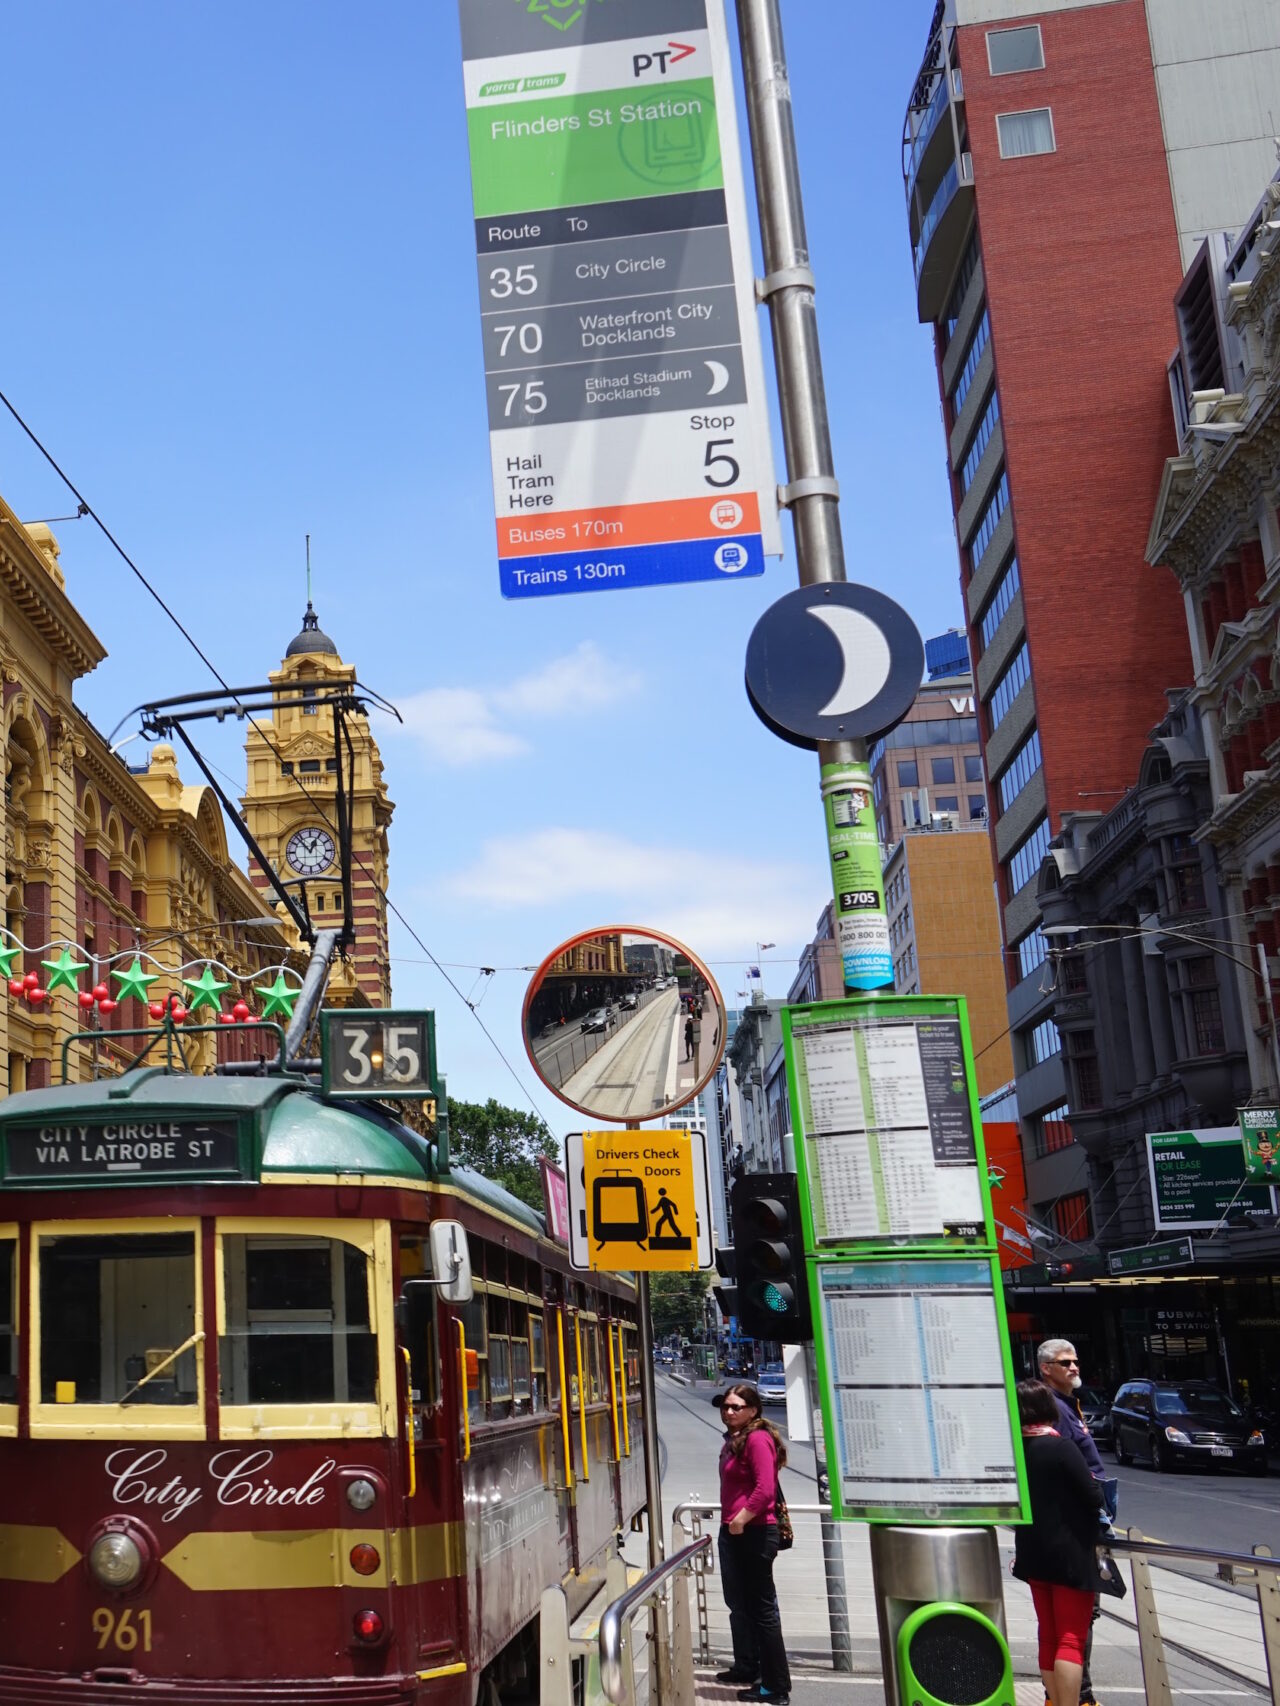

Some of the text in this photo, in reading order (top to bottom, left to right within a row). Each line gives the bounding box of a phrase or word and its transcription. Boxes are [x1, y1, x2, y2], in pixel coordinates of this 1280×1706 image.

[490, 98, 703, 140] Flinders St Station
[487, 217, 588, 243] Route To
[575, 255, 667, 281] City Circle
[488, 264, 539, 299] 35
[578, 302, 714, 332] Waterfront City
[493, 322, 543, 357] 70
[581, 324, 676, 348] Docklands
[584, 367, 693, 391] Etihad Stadium
[498, 380, 548, 417] 75
[585, 383, 661, 404] Docklands
[689, 414, 736, 432] Stop
[506, 454, 543, 472] Hail
[703, 437, 741, 489] 5
[507, 473, 555, 491] Tram
[508, 493, 554, 510] Here
[508, 518, 624, 545] Buses 170m
[512, 561, 627, 587] Trains 130m
[843, 892, 876, 906] 3705
[342, 1026, 420, 1086] 35
[1243, 1110, 1276, 1119] MERRY
[39, 1123, 182, 1145] CITY CIRCLE
[35, 1139, 215, 1165] VIA LATROBE ST
[595, 1147, 680, 1160] Drivers Check
[1154, 1151, 1186, 1162] RETAIL
[644, 1165, 682, 1177] Doors
[1156, 1160, 1201, 1171] FOR LEASE
[957, 1226, 978, 1236] 3705
[1155, 1322, 1217, 1331] TO STATION
[1157, 1310, 1213, 1320] SUBWAY
[104, 1447, 337, 1523] City Circle
[91, 1606, 153, 1652] 961
